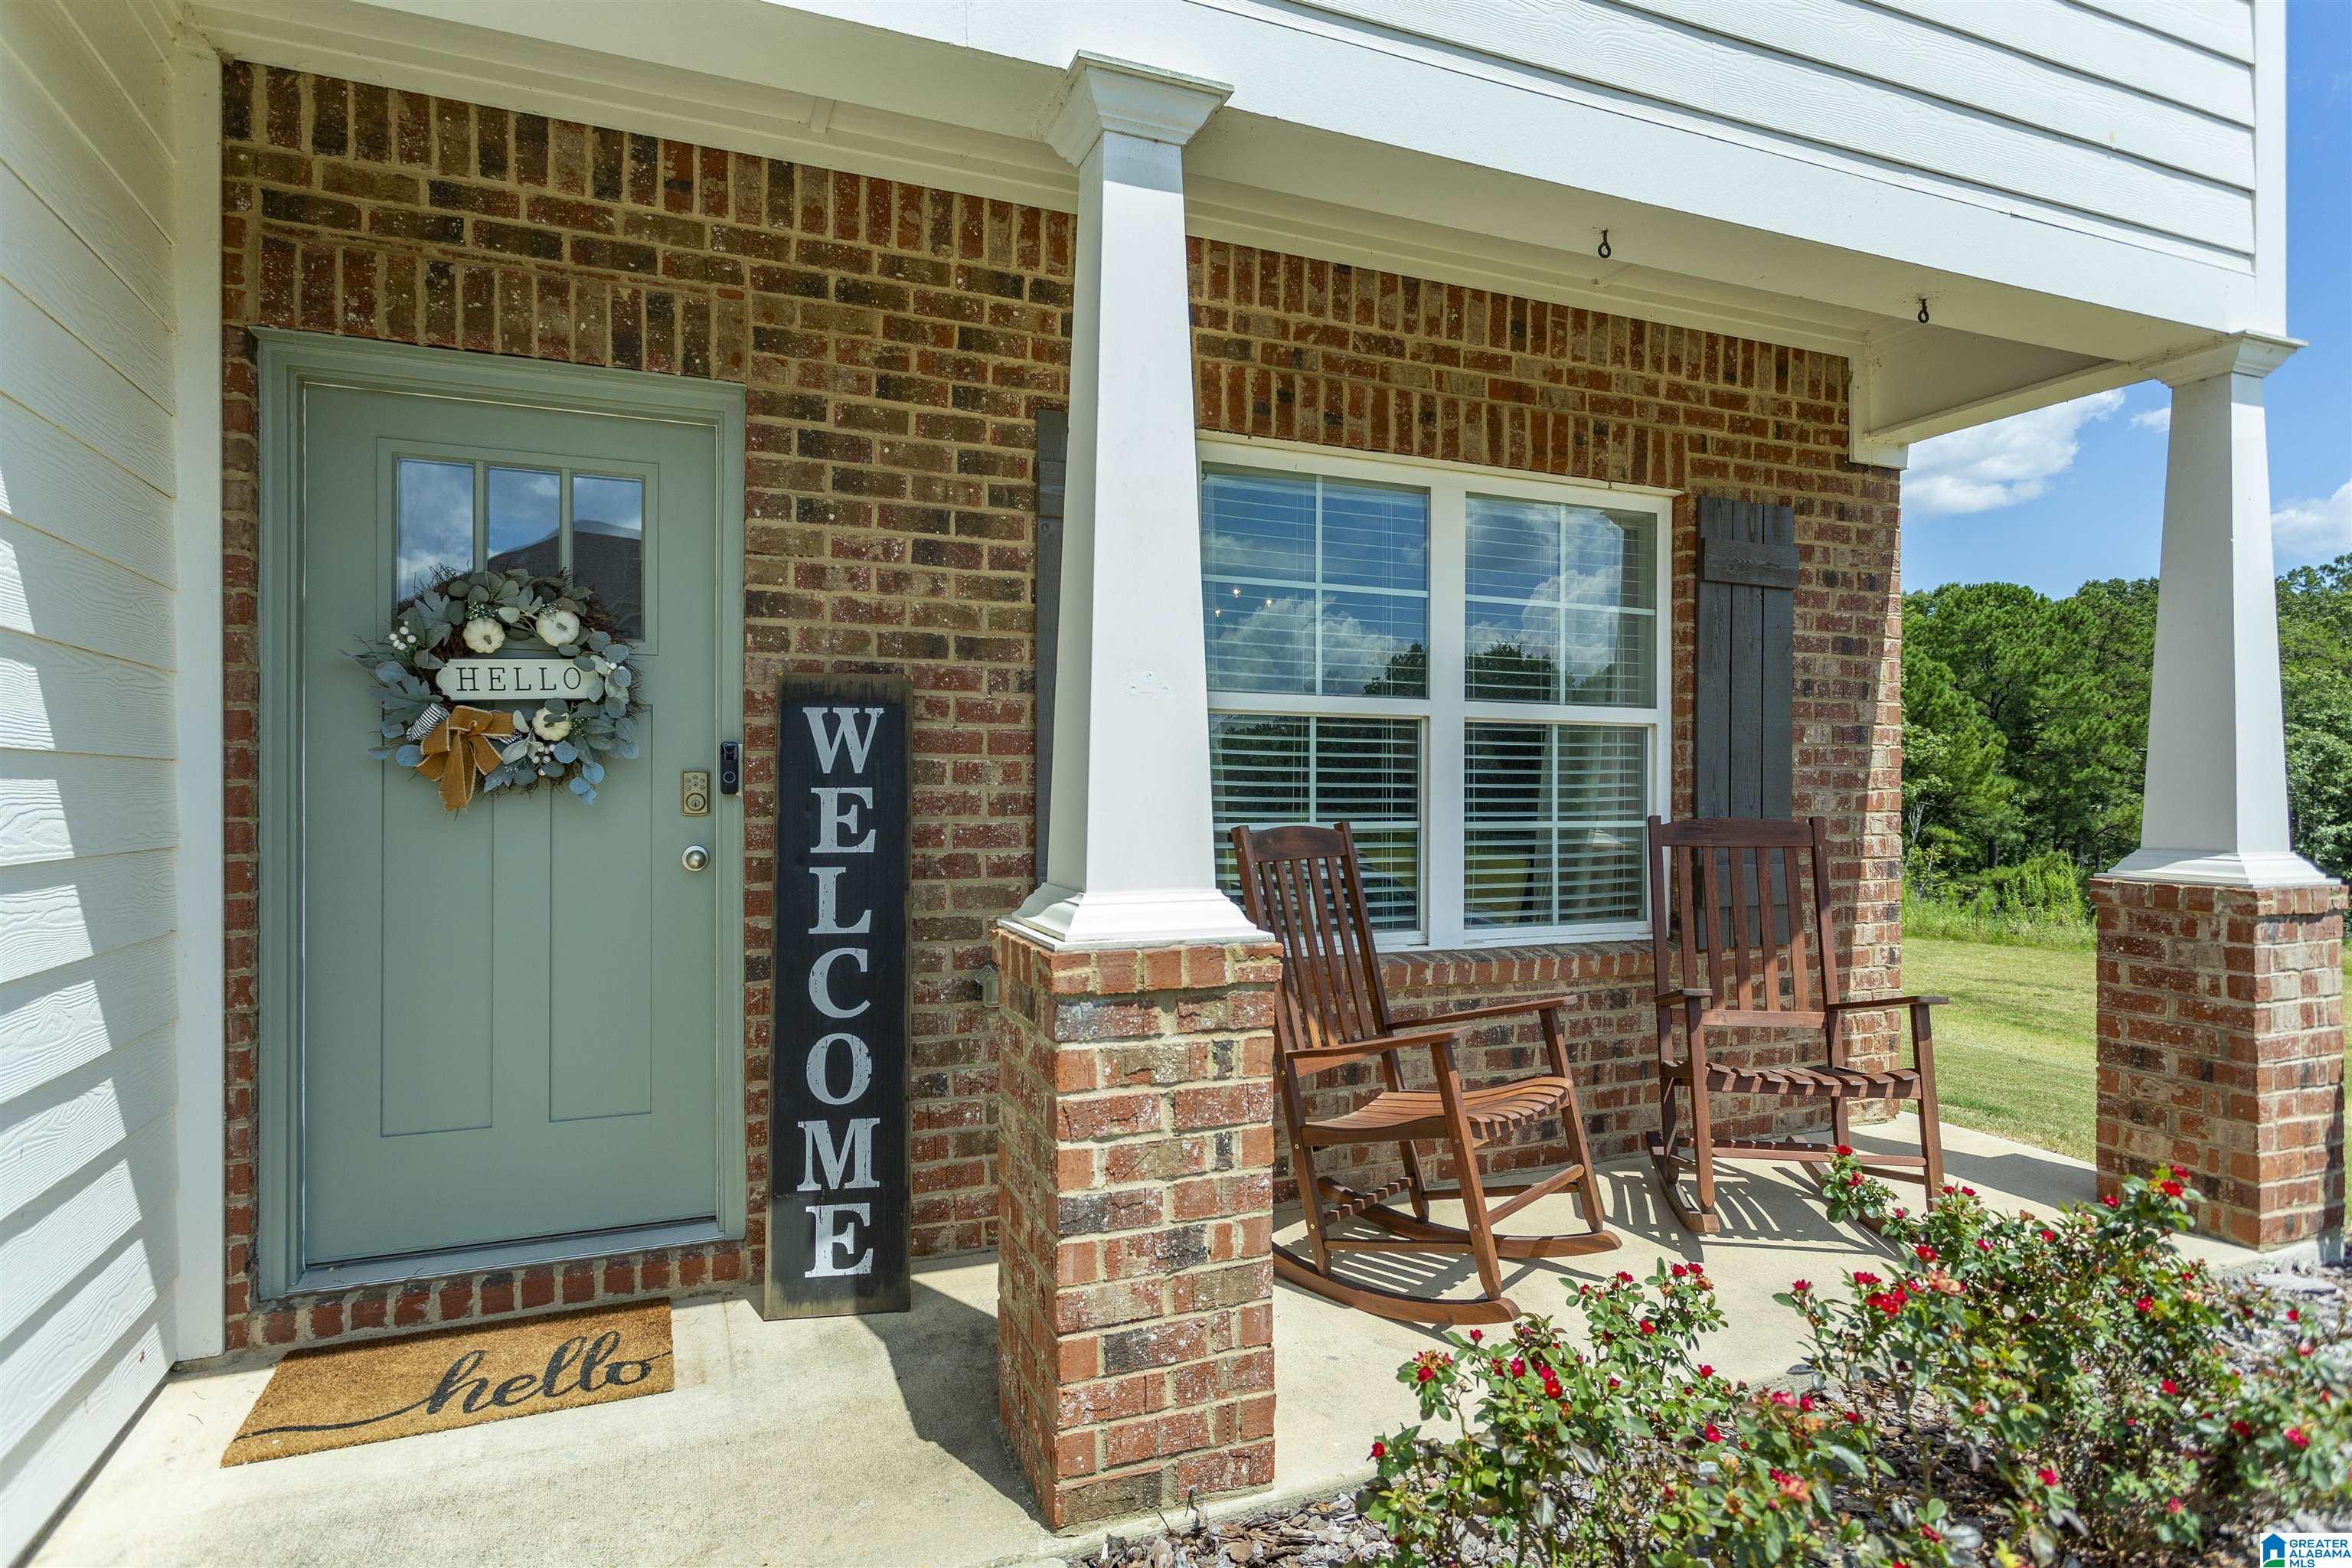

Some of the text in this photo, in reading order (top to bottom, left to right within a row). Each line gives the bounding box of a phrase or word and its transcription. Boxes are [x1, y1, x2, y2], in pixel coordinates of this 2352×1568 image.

[456, 667, 582, 691] HELLO
[796, 706, 884, 1279] WELCOME
[383, 1330, 672, 1417] hello
